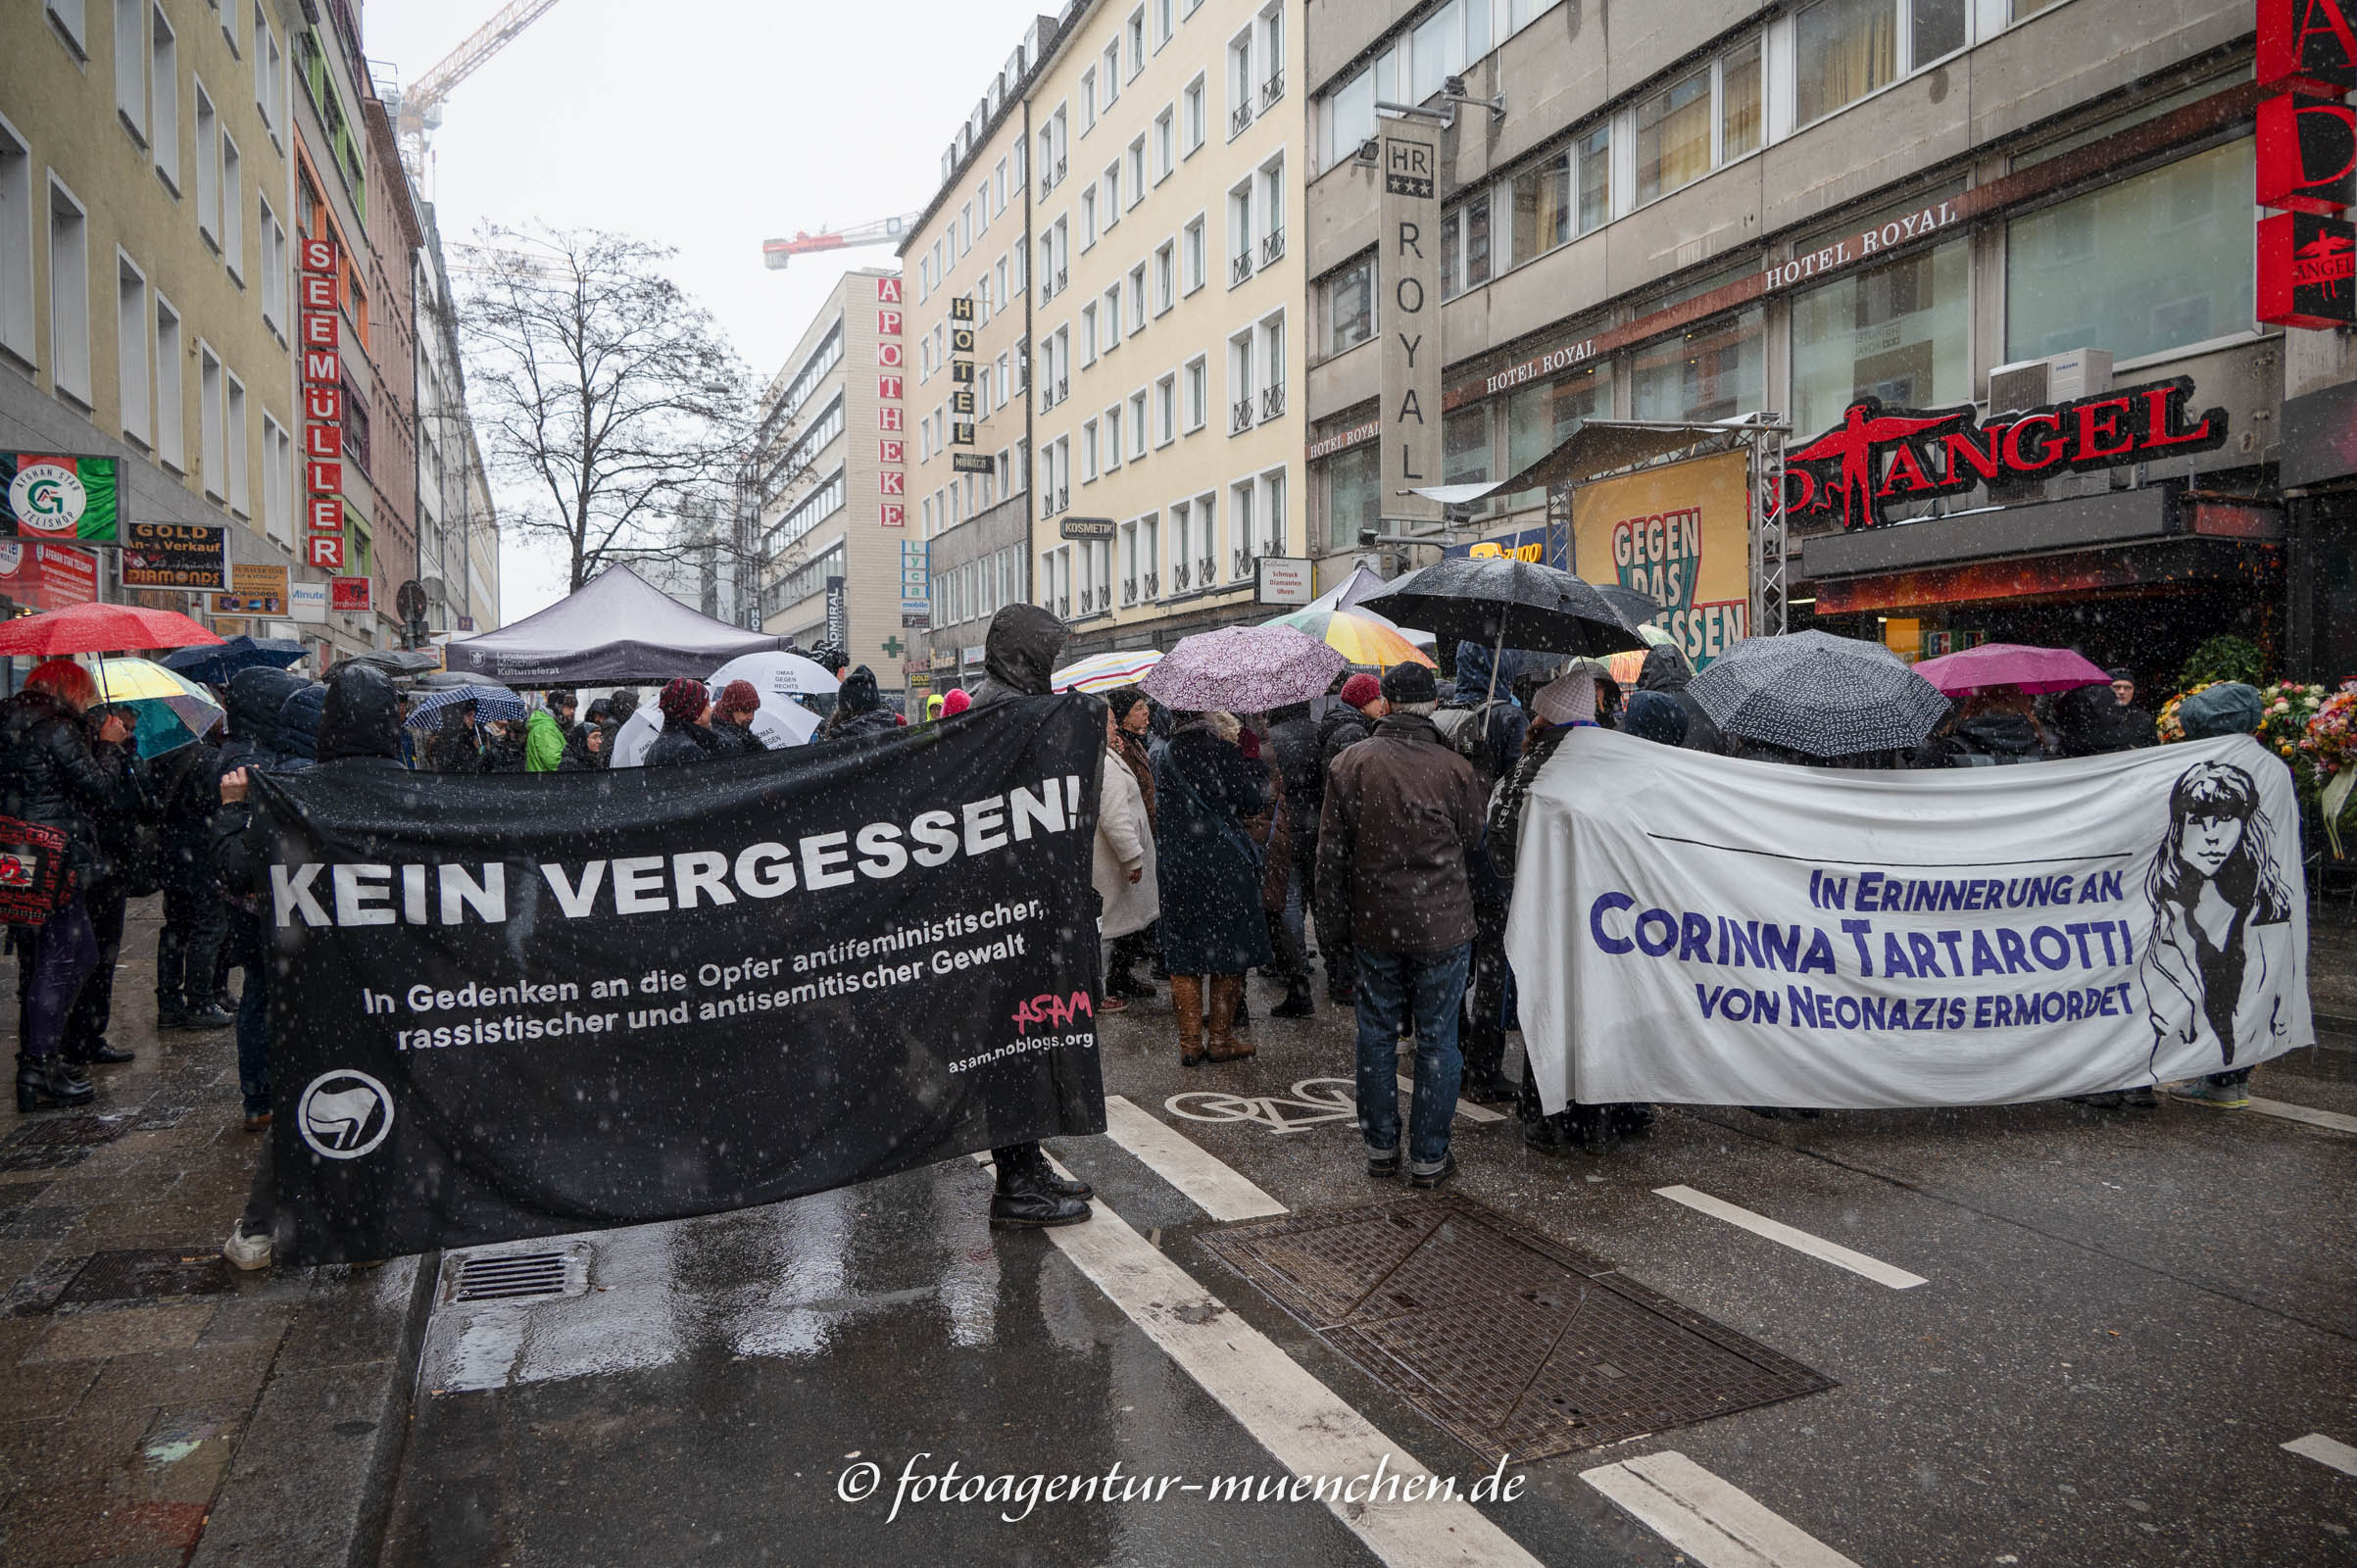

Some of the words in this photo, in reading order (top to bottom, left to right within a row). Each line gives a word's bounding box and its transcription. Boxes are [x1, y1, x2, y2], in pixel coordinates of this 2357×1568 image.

[1393, 146, 1427, 174] HR
[1765, 242, 1851, 291] HOTEL
[1861, 201, 1955, 256] ROYAL
[956, 299, 973, 442] HOTEL
[1397, 221, 1424, 480] ROYAL
[1487, 362, 1537, 394] HOTEL
[1543, 339, 1596, 372] ROYAL
[308, 242, 338, 564] SEEMÜLLER
[880, 279, 903, 526] APOTHEKE
[1310, 436, 1344, 459] HOTEL
[1876, 387, 2211, 498] ANGEL
[17, 468, 53, 488] AFGHAN
[59, 471, 80, 492] STAR
[24, 510, 74, 527] TELISHOP
[136, 523, 208, 539] GOLD
[1065, 522, 1113, 534] KOSMETIK
[1614, 512, 1699, 566] GEGEN
[164, 540, 221, 552] Verkauf
[911, 540, 920, 596] Lyca
[498, 667, 560, 676] Kulturreferat
[270, 861, 507, 927] KEIN
[540, 775, 1080, 918] VERGESSEN!
[1854, 871, 2074, 911] ERINNERUNG
[2078, 869, 2124, 904] AN
[363, 987, 395, 1014] In
[408, 980, 578, 1011] Gedenken
[591, 977, 629, 1000] an
[640, 970, 686, 994] die
[698, 956, 783, 989] Opfer
[793, 898, 1045, 971] antifeministischer,
[1590, 891, 1837, 975] CORINNA
[1841, 918, 2134, 978] TARTAROTTI
[398, 1010, 619, 1051] rassistischer
[628, 1000, 689, 1029] und
[699, 958, 924, 1021] antisemitischer
[931, 932, 1026, 975] Gewalt
[1695, 983, 1781, 1025] VON
[1787, 984, 1967, 1030] NEONAZIS
[1974, 982, 2134, 1029] ERMORDET
[948, 1031, 1094, 1075] asam.noblogs.org
